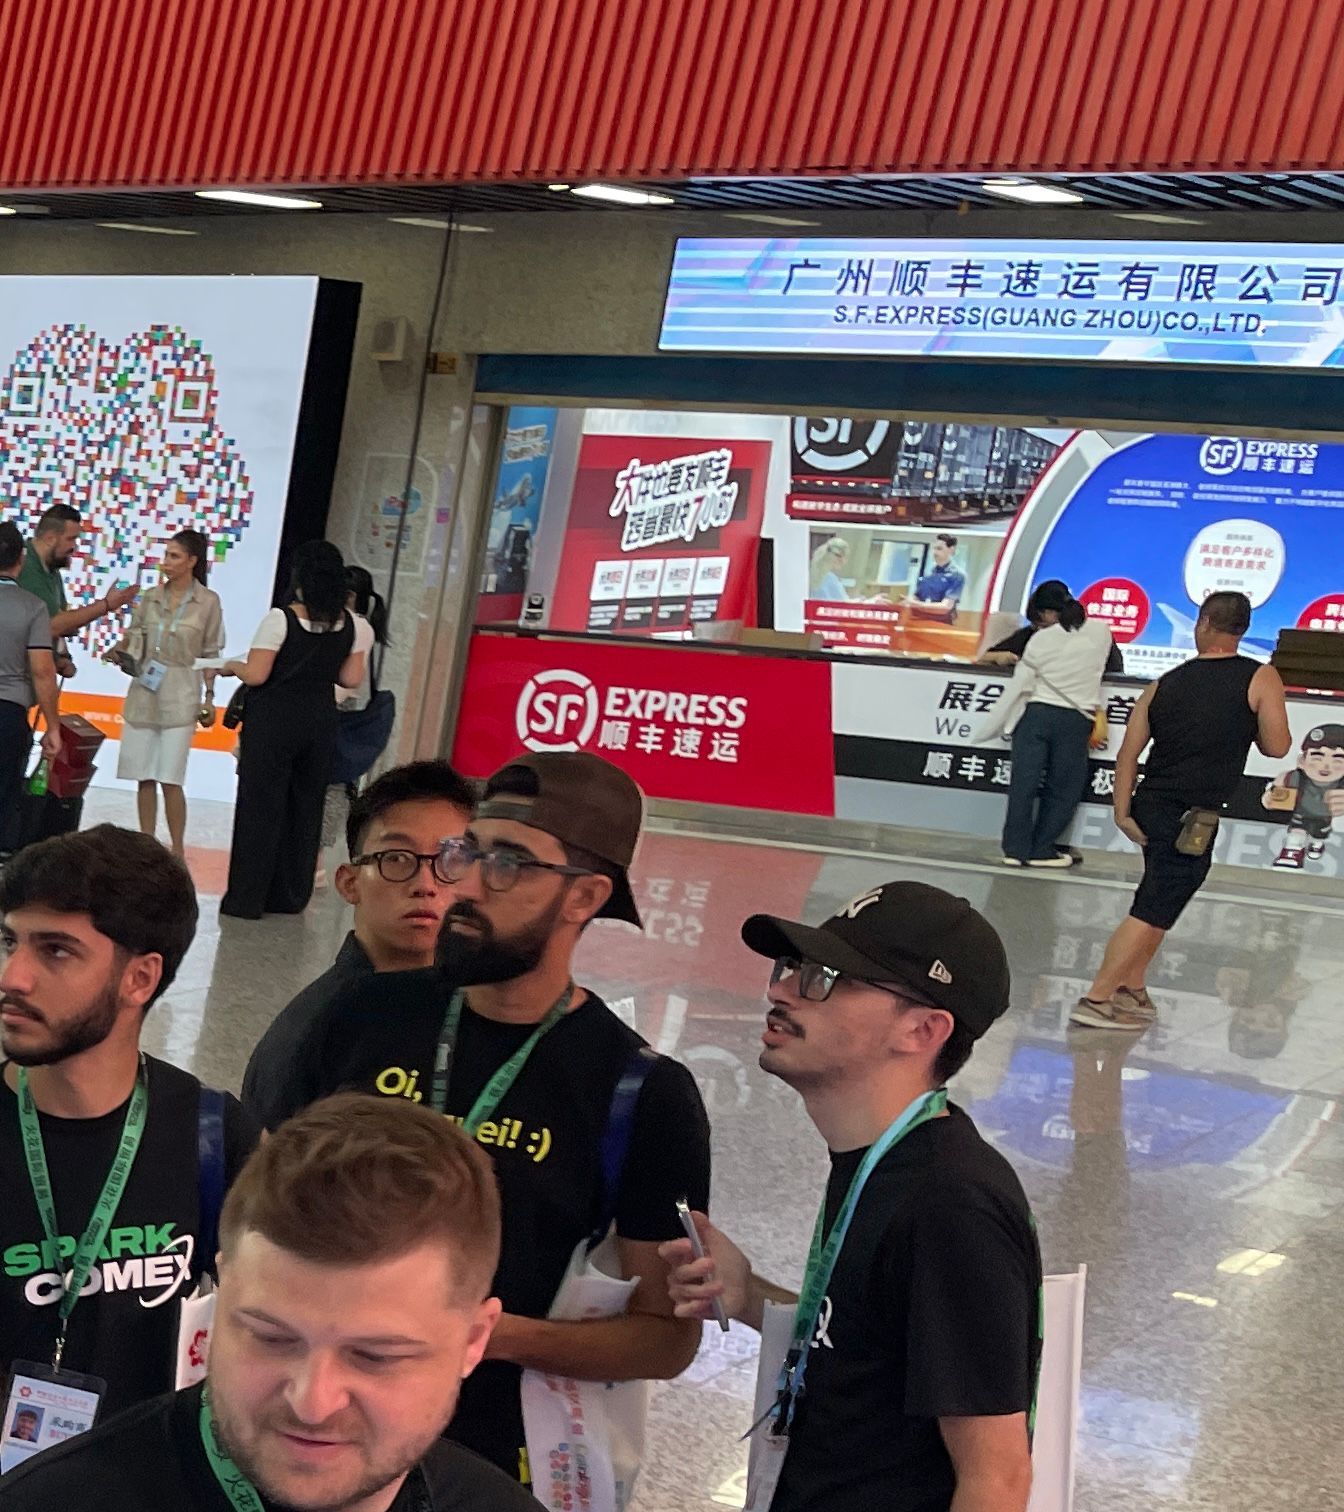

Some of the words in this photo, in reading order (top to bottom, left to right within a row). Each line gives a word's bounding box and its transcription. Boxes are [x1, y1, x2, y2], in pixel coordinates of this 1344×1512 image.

[782, 258, 1344, 305] 广州顺丰速运有限公司
[1242, 457, 1314, 474] 顺丰速运
[1246, 440, 1319, 459] EXPRESS
[530, 692, 584, 735] SF
[604, 687, 748, 728] EXPRESS
[935, 716, 972, 738] We
[597, 720, 741, 763] 顺丰速运
[375, 1066, 423, 1102] Oi,
[3, 1223, 178, 1277] SPARK
[24, 1254, 192, 1306] COMEX
